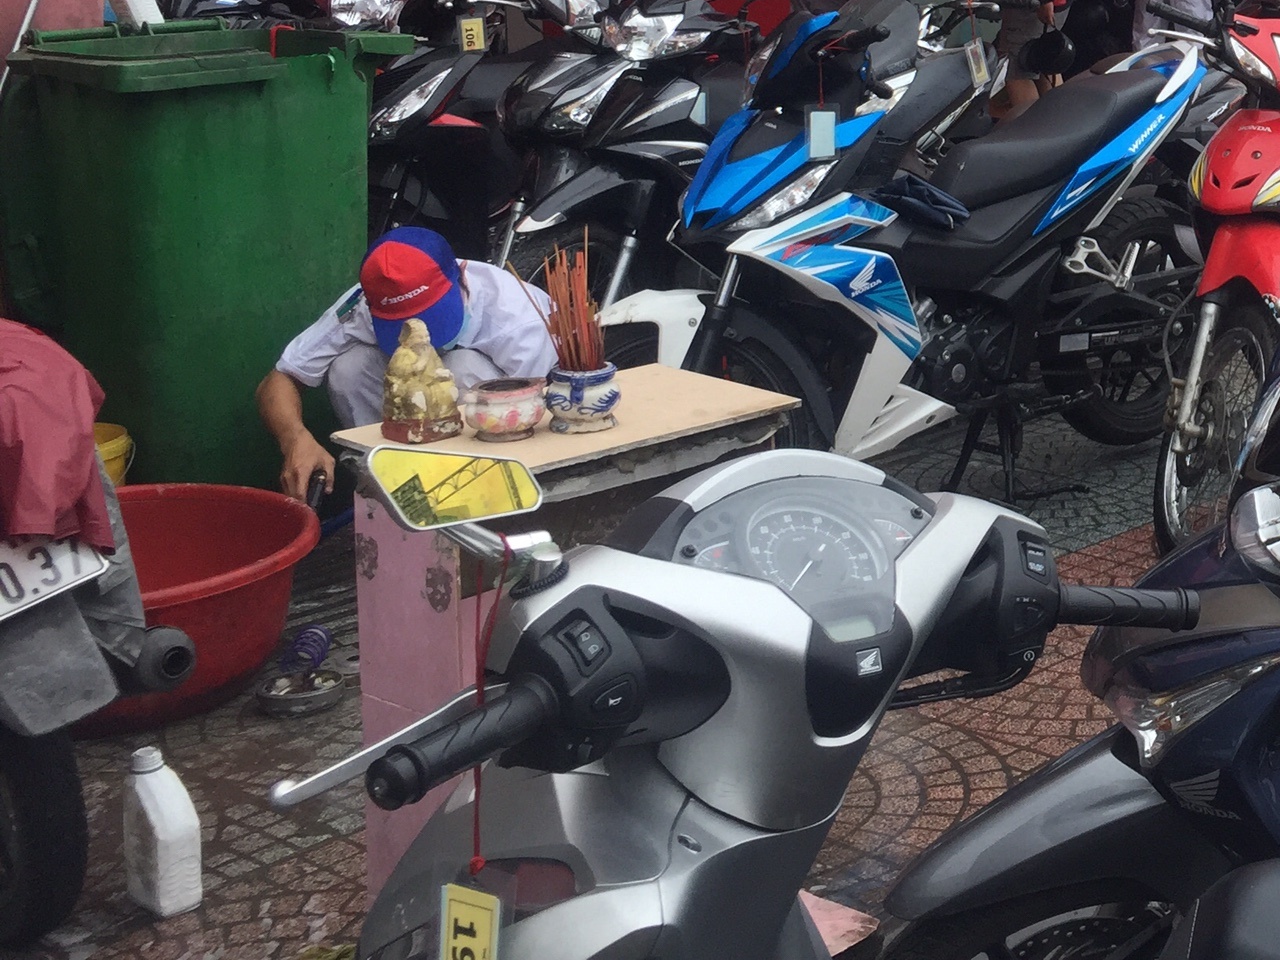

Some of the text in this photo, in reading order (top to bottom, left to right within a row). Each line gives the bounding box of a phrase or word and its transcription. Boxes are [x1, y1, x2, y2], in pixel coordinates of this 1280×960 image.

[464, 26, 476, 48] 106
[1127, 112, 1166, 154] WINNER
[1237, 125, 1273, 133] HONDA
[387, 284, 430, 305] HONDA
[850, 277, 883, 299] HONDA
[1180, 799, 1242, 820] HONDA
